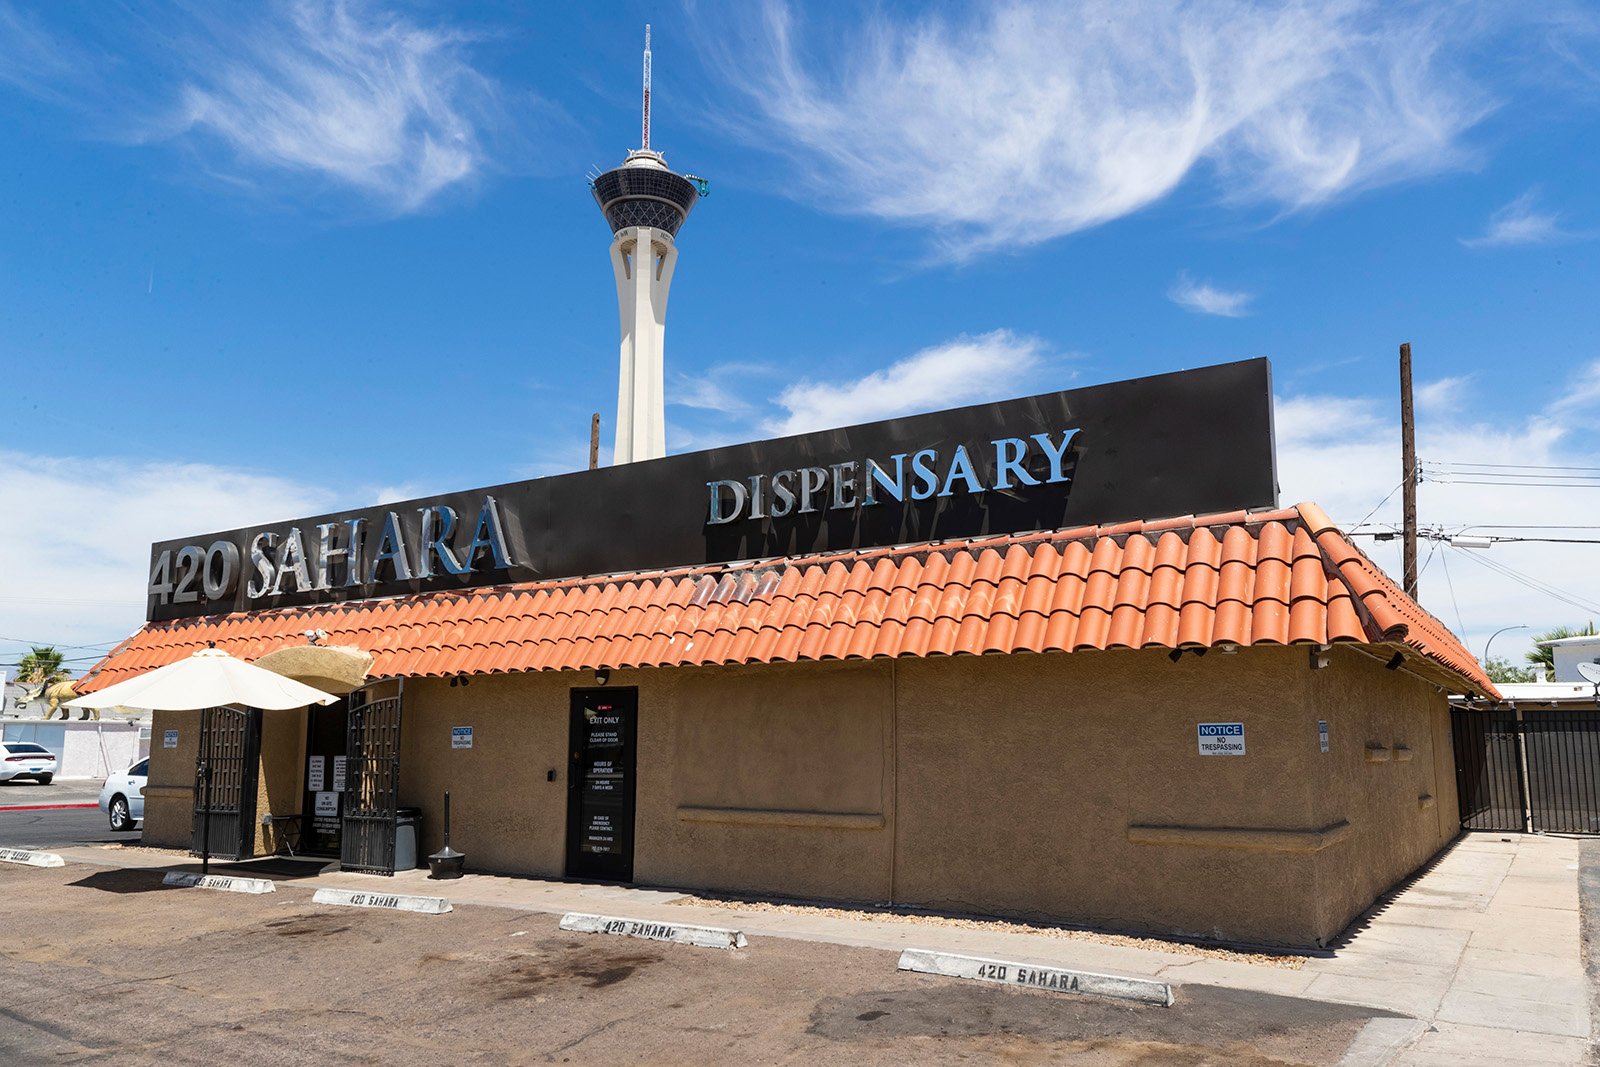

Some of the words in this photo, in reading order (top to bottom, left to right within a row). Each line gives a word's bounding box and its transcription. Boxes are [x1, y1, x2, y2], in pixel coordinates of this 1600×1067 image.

[706, 428, 1082, 525] DISPENSARY
[149, 541, 239, 605] 420
[247, 495, 517, 599] SAHARA
[590, 716, 602, 724] EXIT
[603, 716, 619, 724] ONLY
[1201, 726, 1240, 735] NOTICE
[1202, 743, 1242, 751] TRESPASSING
[350, 894, 365, 904] 420
[368, 895, 399, 907] SAHARA
[605, 921, 625, 932] 420
[631, 923, 672, 938] SAHARA
[978, 964, 1006, 980] 420
[1017, 968, 1078, 991] SAHARA
